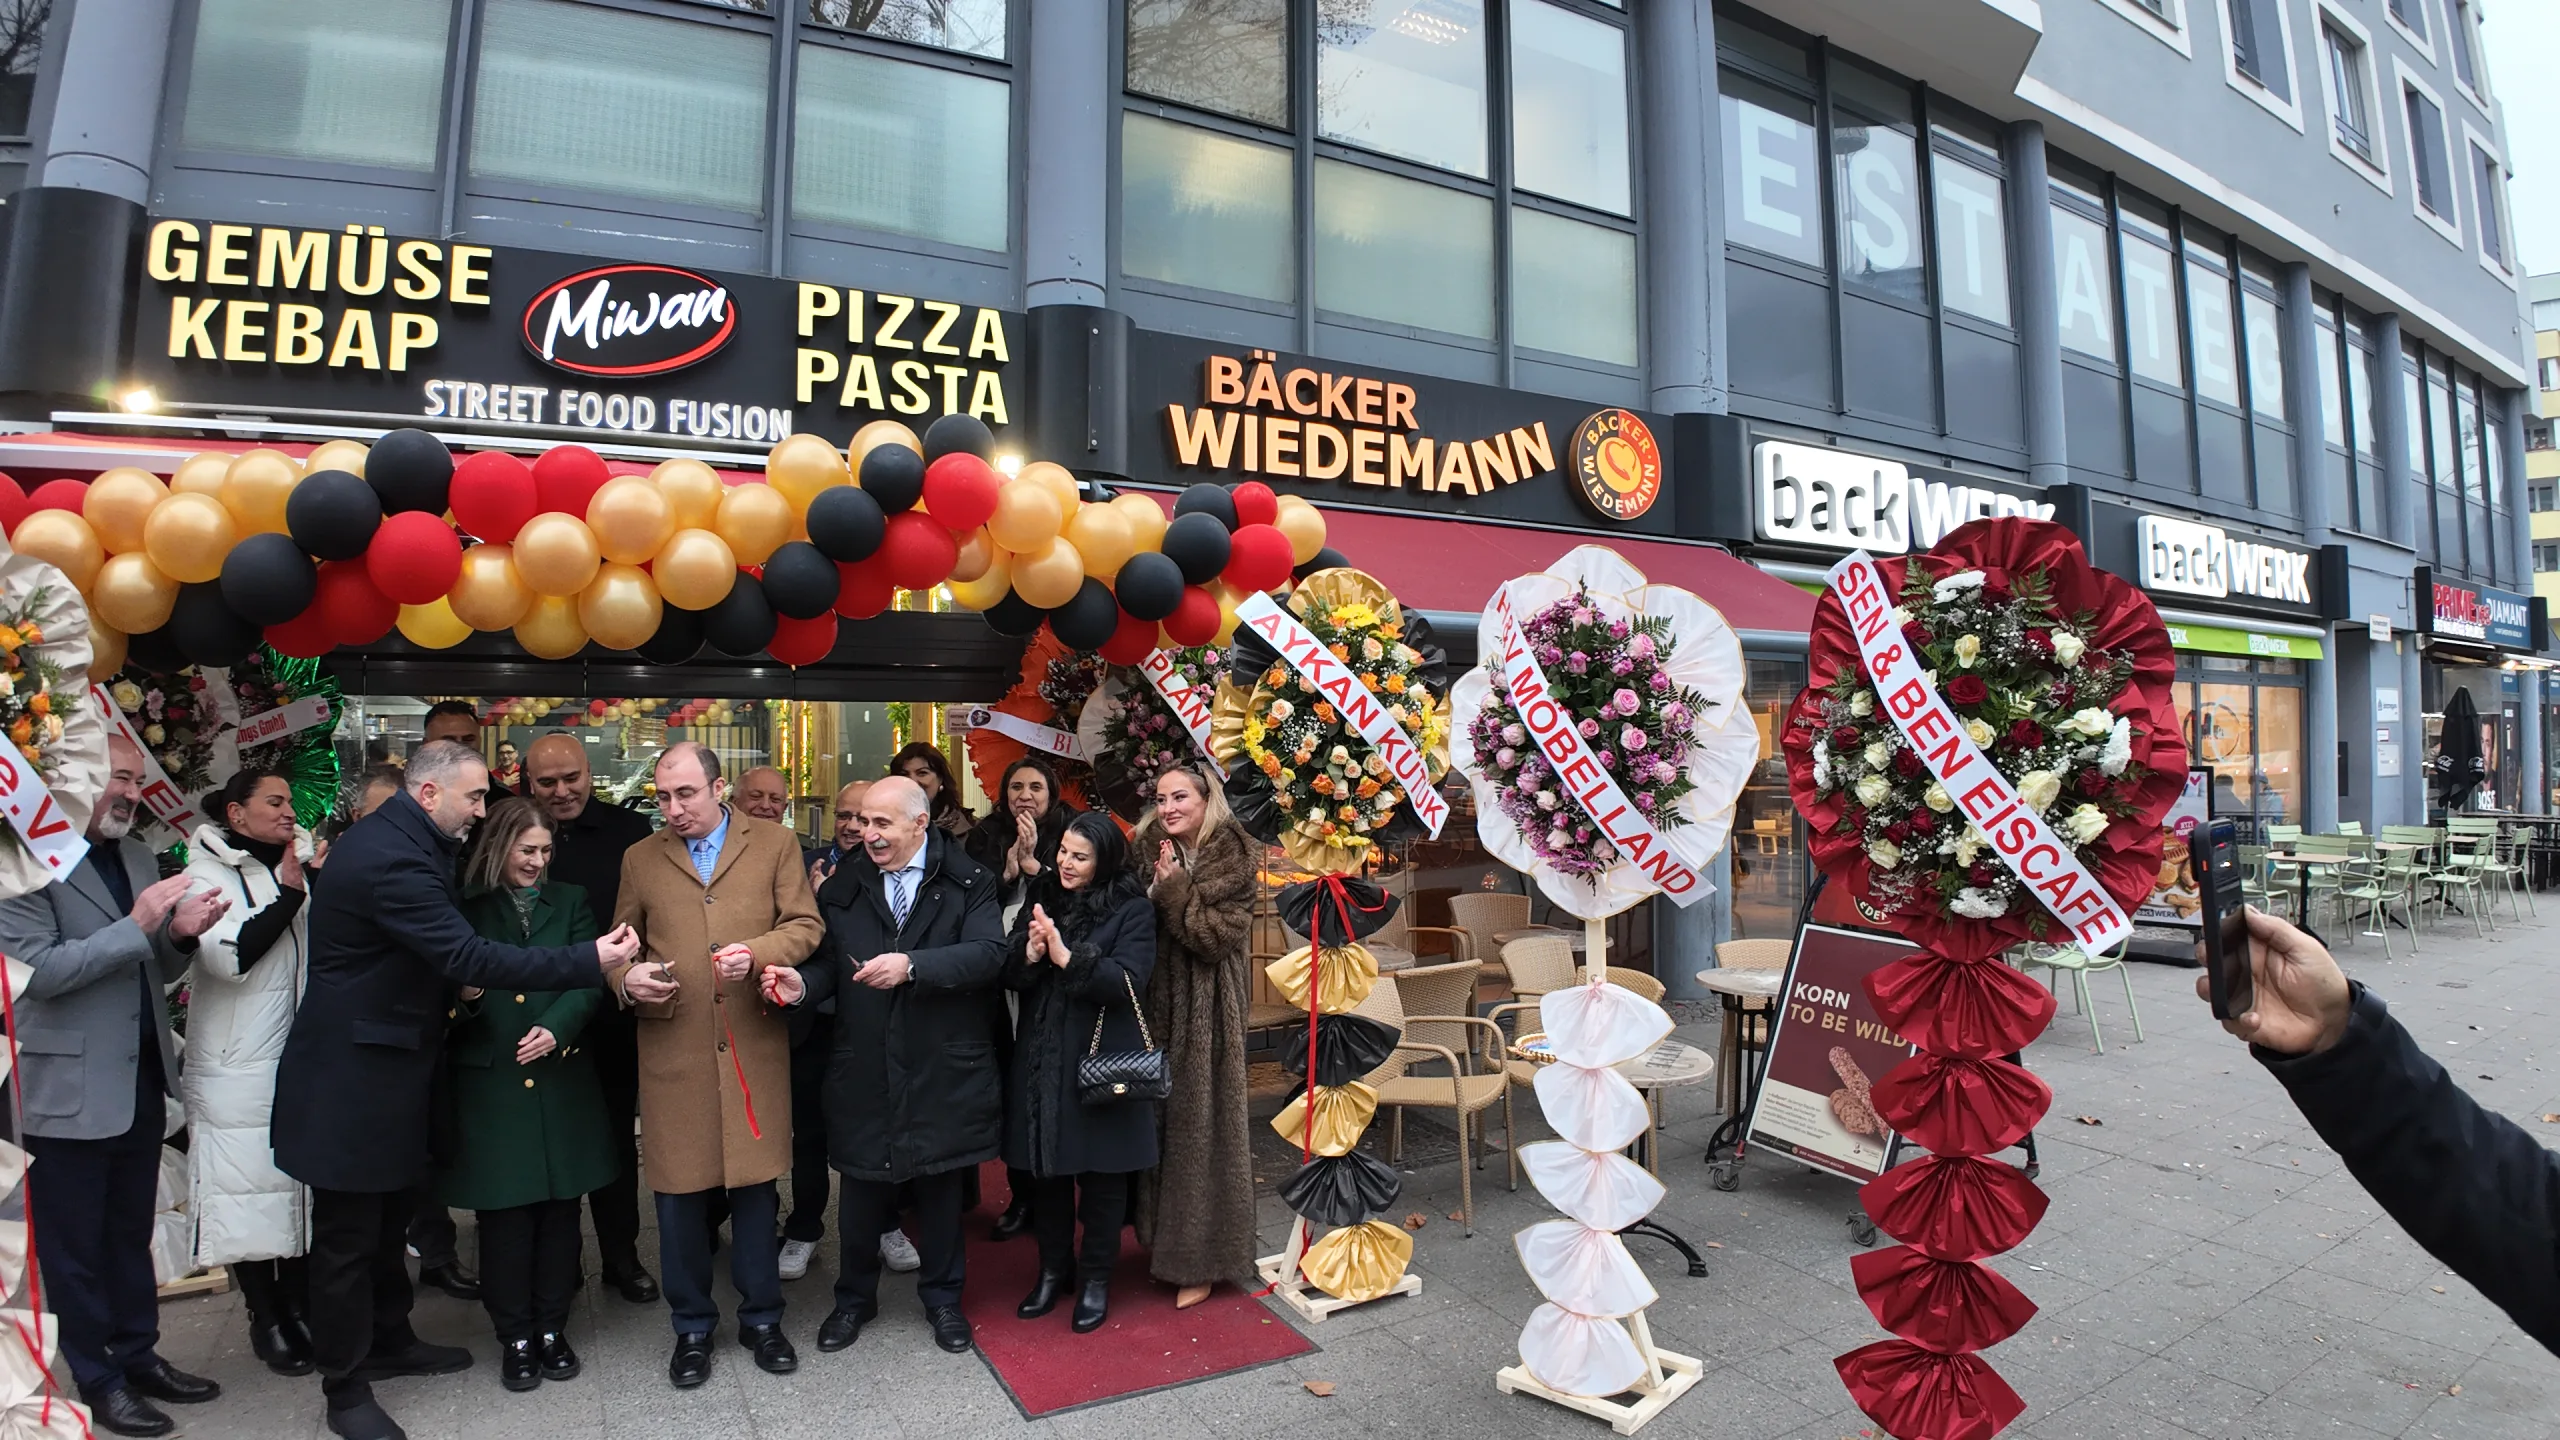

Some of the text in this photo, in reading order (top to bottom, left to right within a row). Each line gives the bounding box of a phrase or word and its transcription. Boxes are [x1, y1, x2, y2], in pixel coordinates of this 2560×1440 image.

[147, 220, 493, 305] GEMÜSE
[168, 296, 440, 371] KEBAP
[543, 279, 728, 361] Miwan
[797, 282, 1010, 363] PIZZA
[424, 379, 793, 442] STREET FOOD FUSION
[796, 347, 1009, 425] PASTA
[1208, 350, 1419, 430] BÄCKER
[1168, 403, 1556, 496] WIEDEMANN
[1586, 416, 1651, 453] BÄCKER
[1583, 455, 1655, 513] WIEDEMANN
[1773, 452, 2056, 549] backW
[2152, 524, 2310, 604] backWERK
[2433, 583, 2476, 623] PRIME
[2486, 598, 2527, 627] DIAMANT
[1141, 652, 1211, 730] PLAN
[1251, 613, 1380, 731] AYKAN
[1837, 562, 1889, 644] SEN
[1871, 648, 1903, 684] &
[1888, 677, 1974, 781] BEN
[258, 712, 287, 736] GmbH
[1511, 666, 1697, 894] MÖBELLAND
[1790, 1004, 1908, 1047] TO BE WILD
[1794, 982, 1850, 1010] KORN
